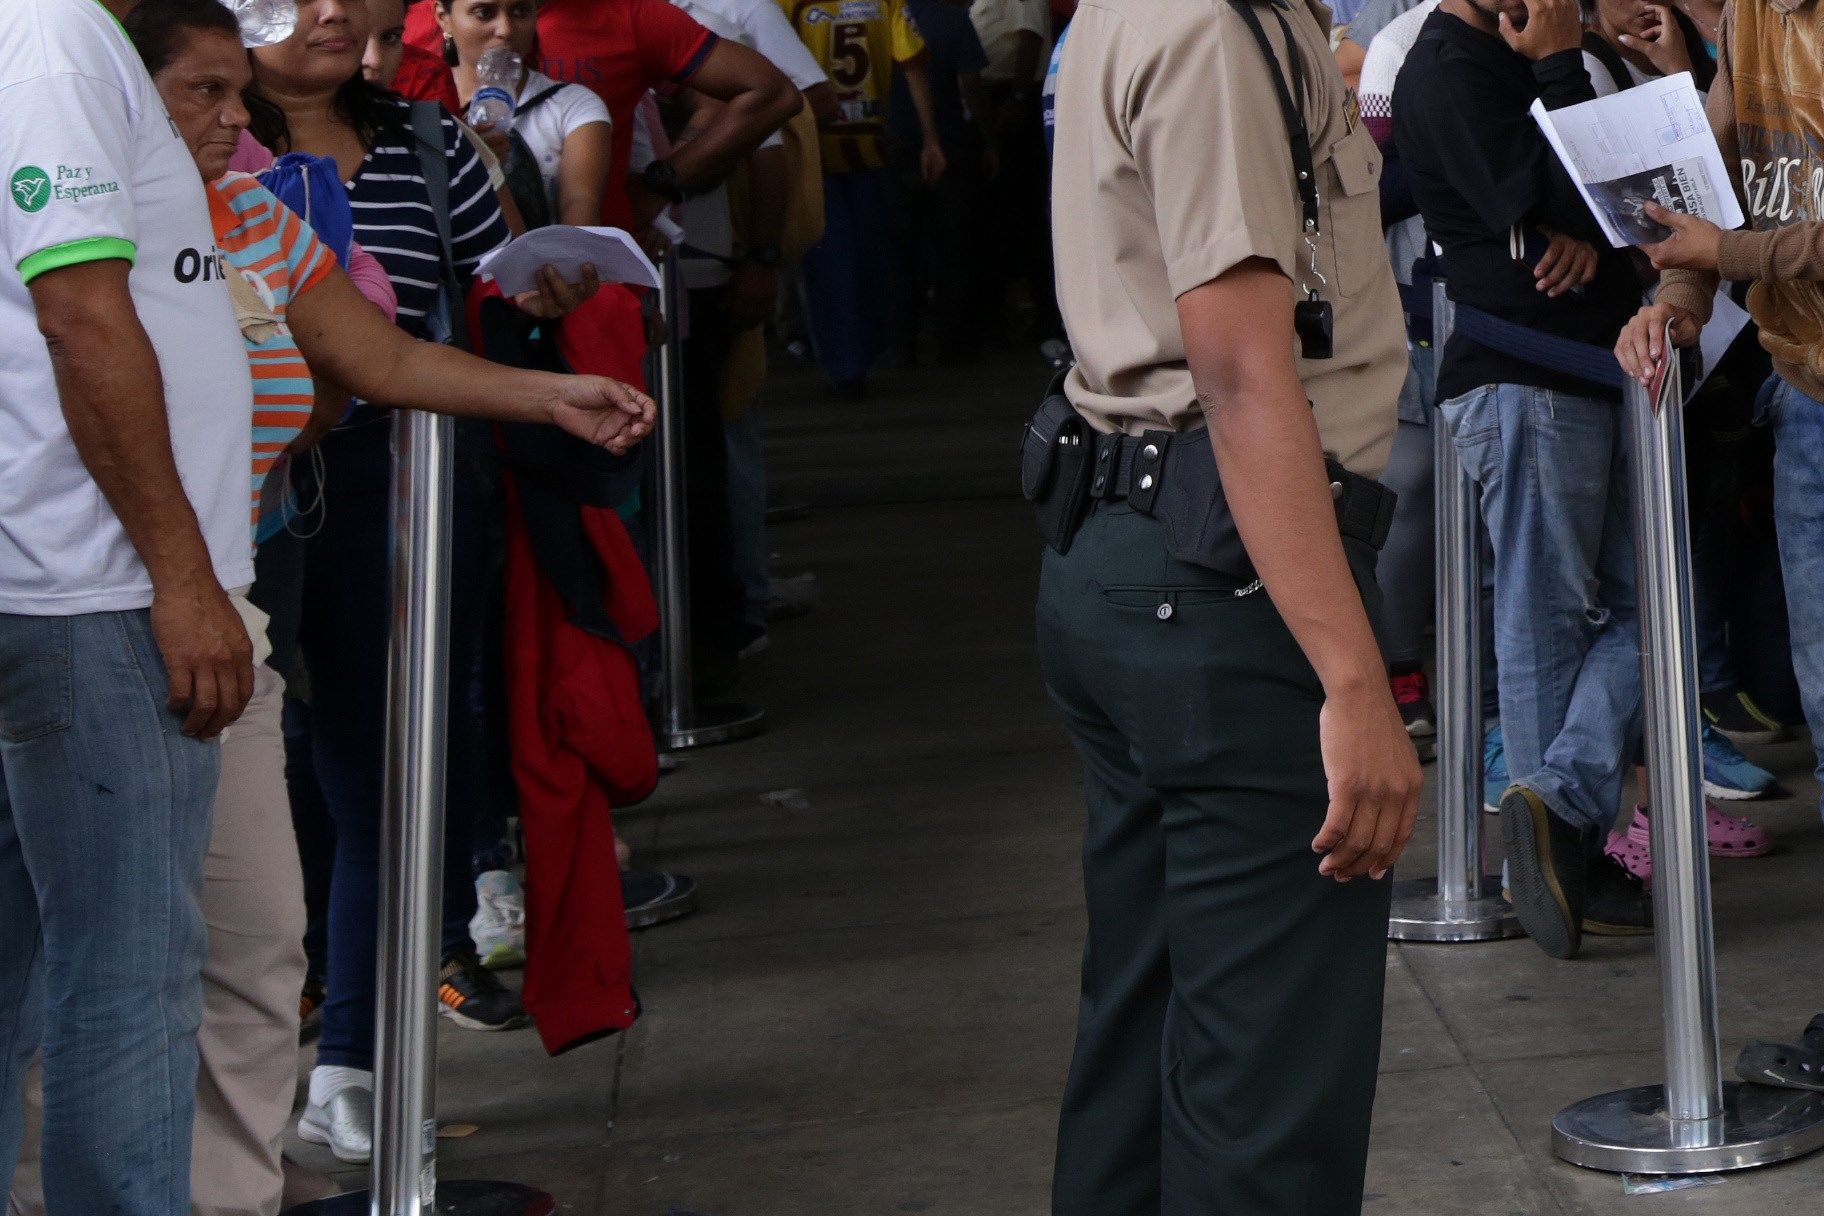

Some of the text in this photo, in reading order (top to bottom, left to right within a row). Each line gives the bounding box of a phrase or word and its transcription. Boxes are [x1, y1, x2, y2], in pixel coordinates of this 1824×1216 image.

[832, 22, 870, 87] 5
[57, 165, 93, 181] Paz y
[1675, 167, 1692, 194] BIEN
[53, 181, 120, 203] Esperanza
